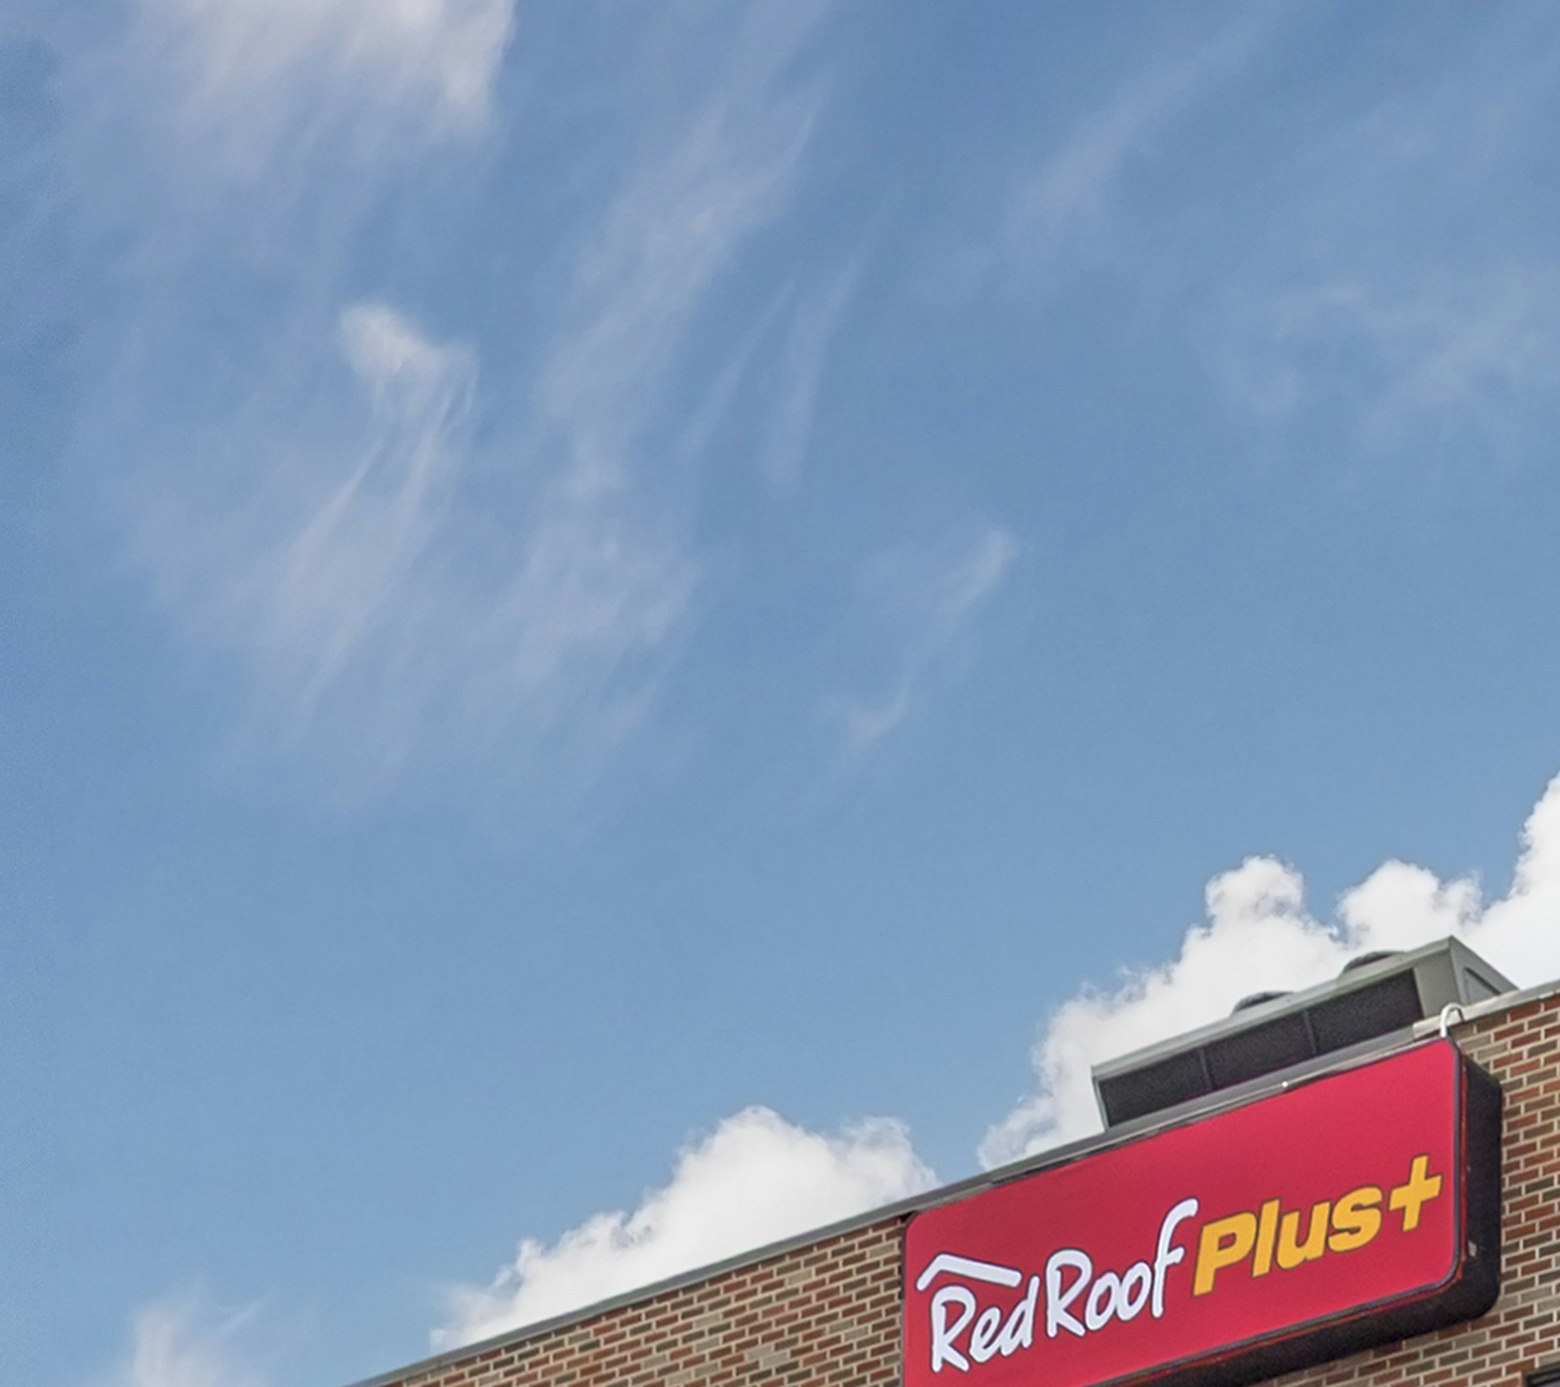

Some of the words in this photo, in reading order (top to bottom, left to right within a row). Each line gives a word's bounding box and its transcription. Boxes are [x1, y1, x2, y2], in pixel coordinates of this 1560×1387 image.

[930, 1275, 1040, 1373] Red
[1045, 1197, 1199, 1338] Roof
[1192, 1155, 1443, 1296] Plus+
